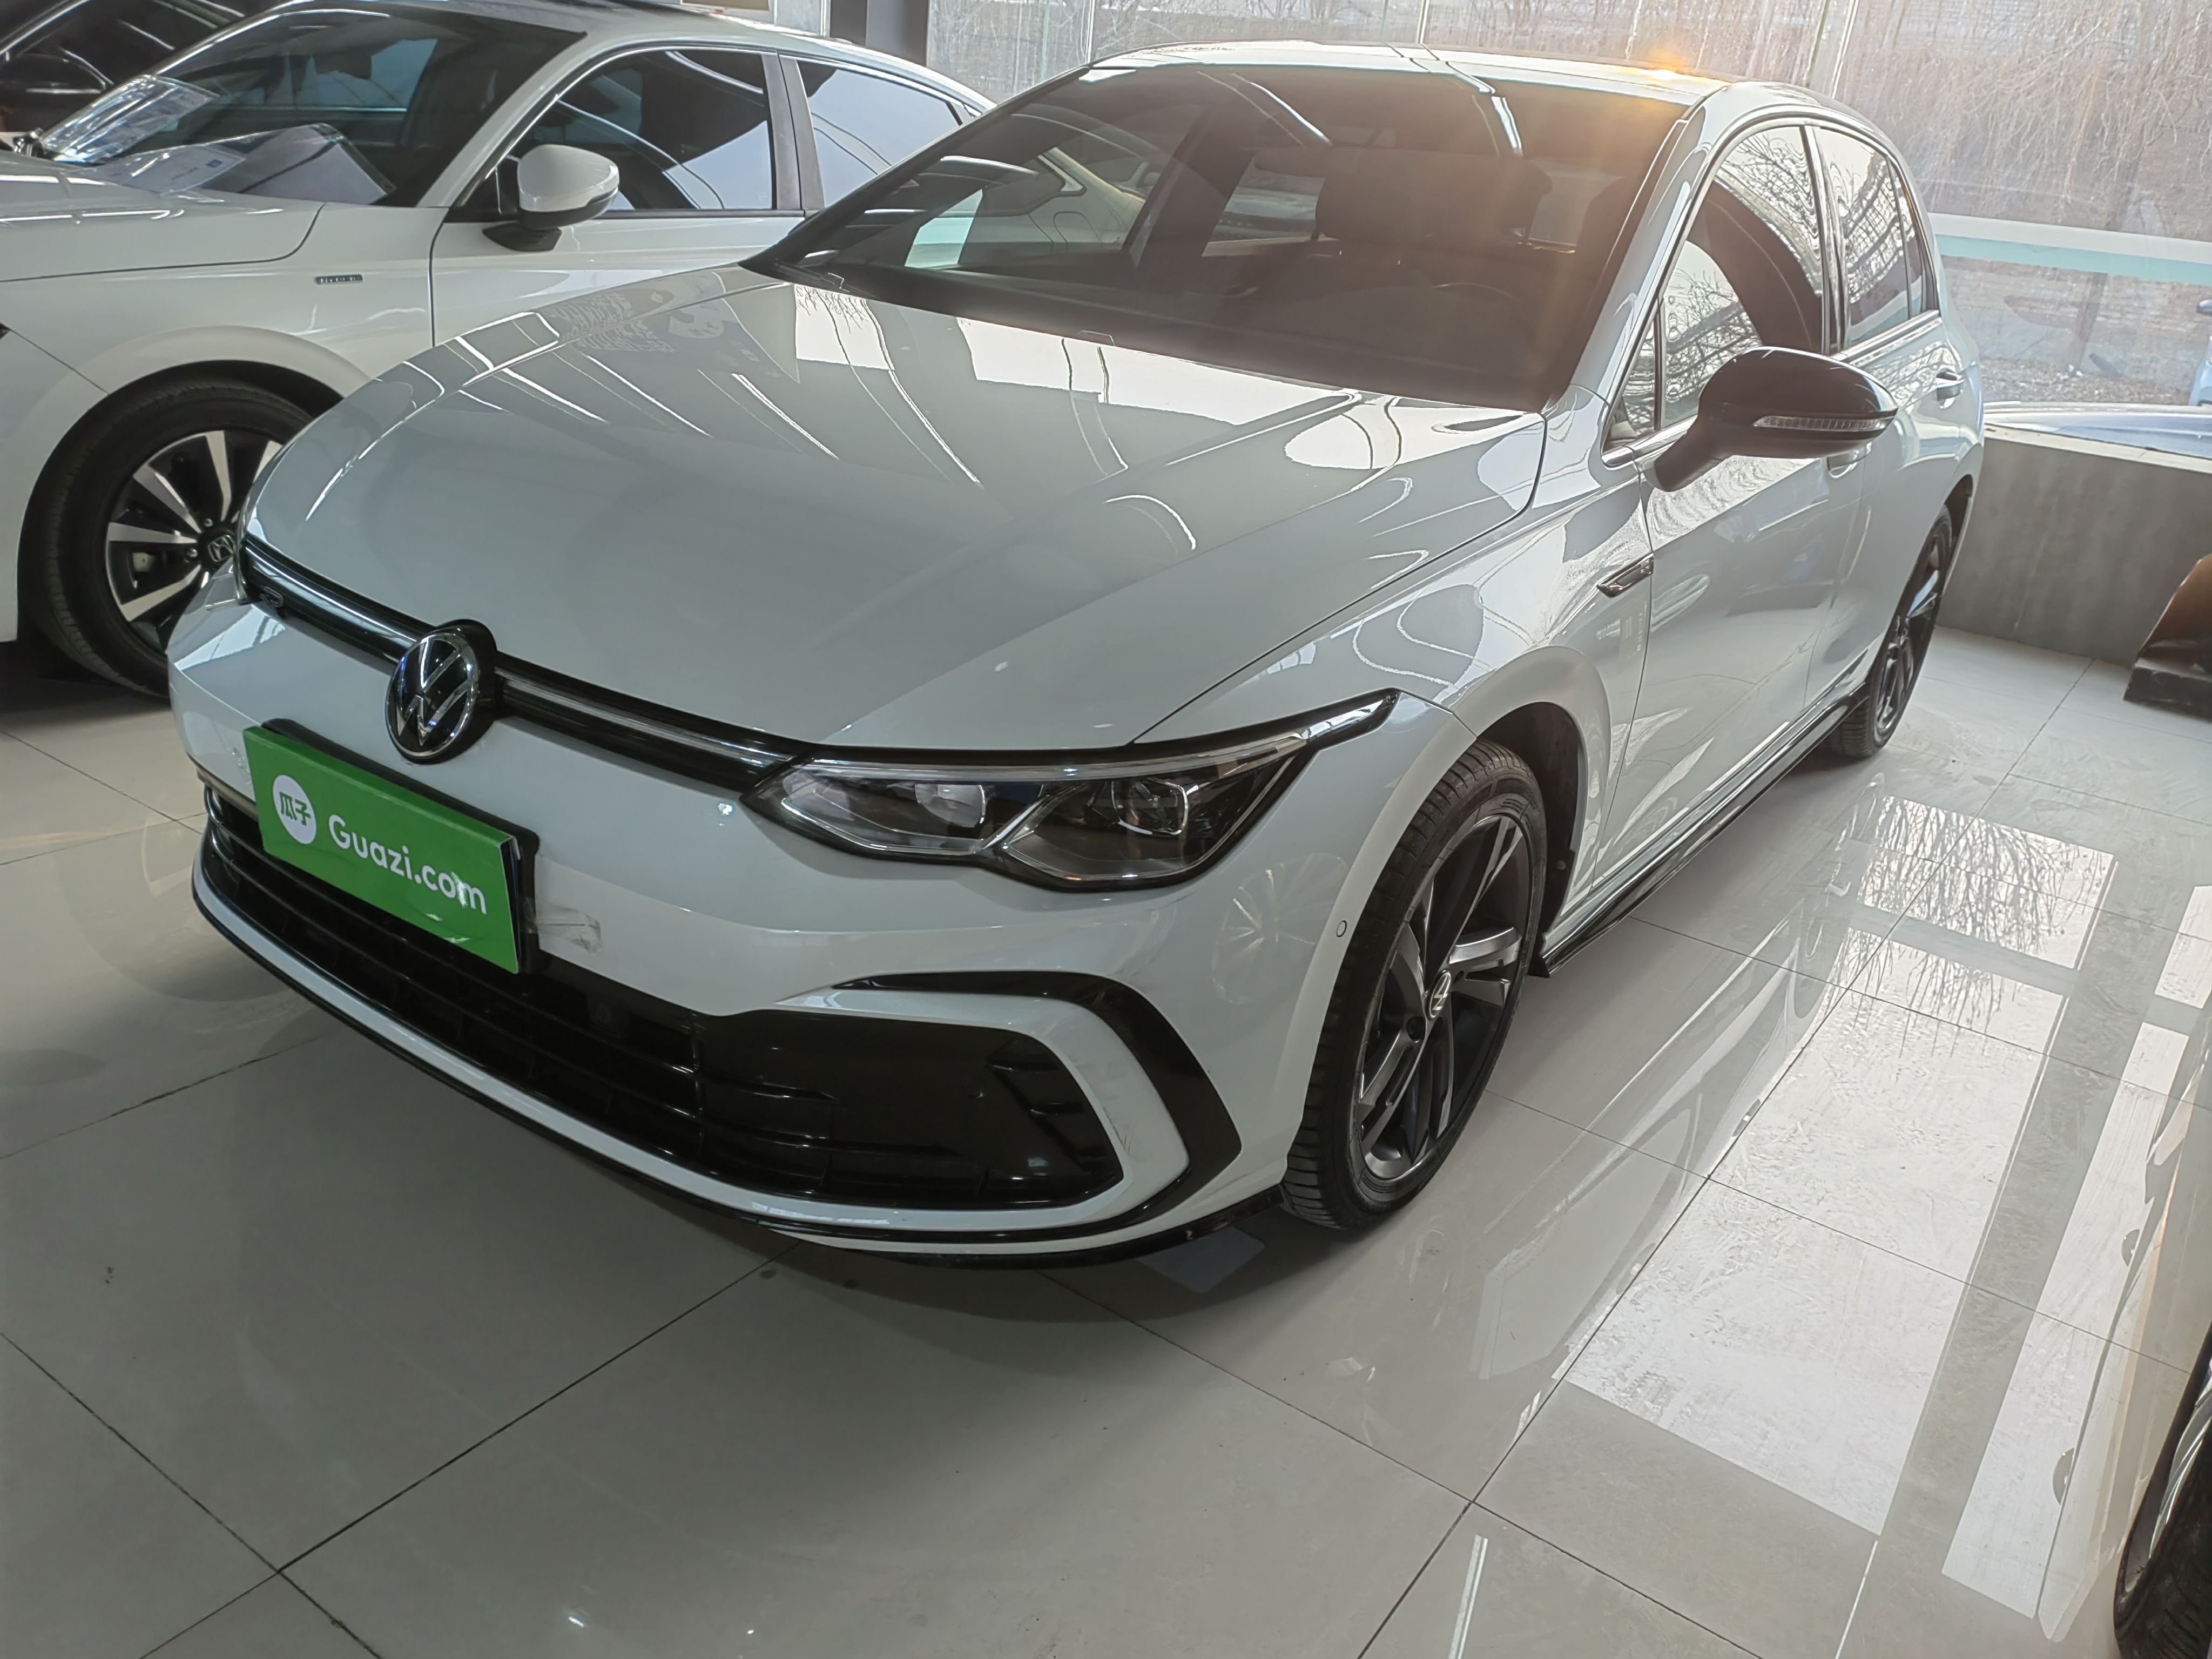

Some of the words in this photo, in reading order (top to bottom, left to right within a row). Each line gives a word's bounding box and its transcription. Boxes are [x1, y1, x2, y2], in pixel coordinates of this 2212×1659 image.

[385, 632, 479, 757] VW
[279, 791, 312, 826] 瓜子
[328, 814, 487, 915] Guazi.com
